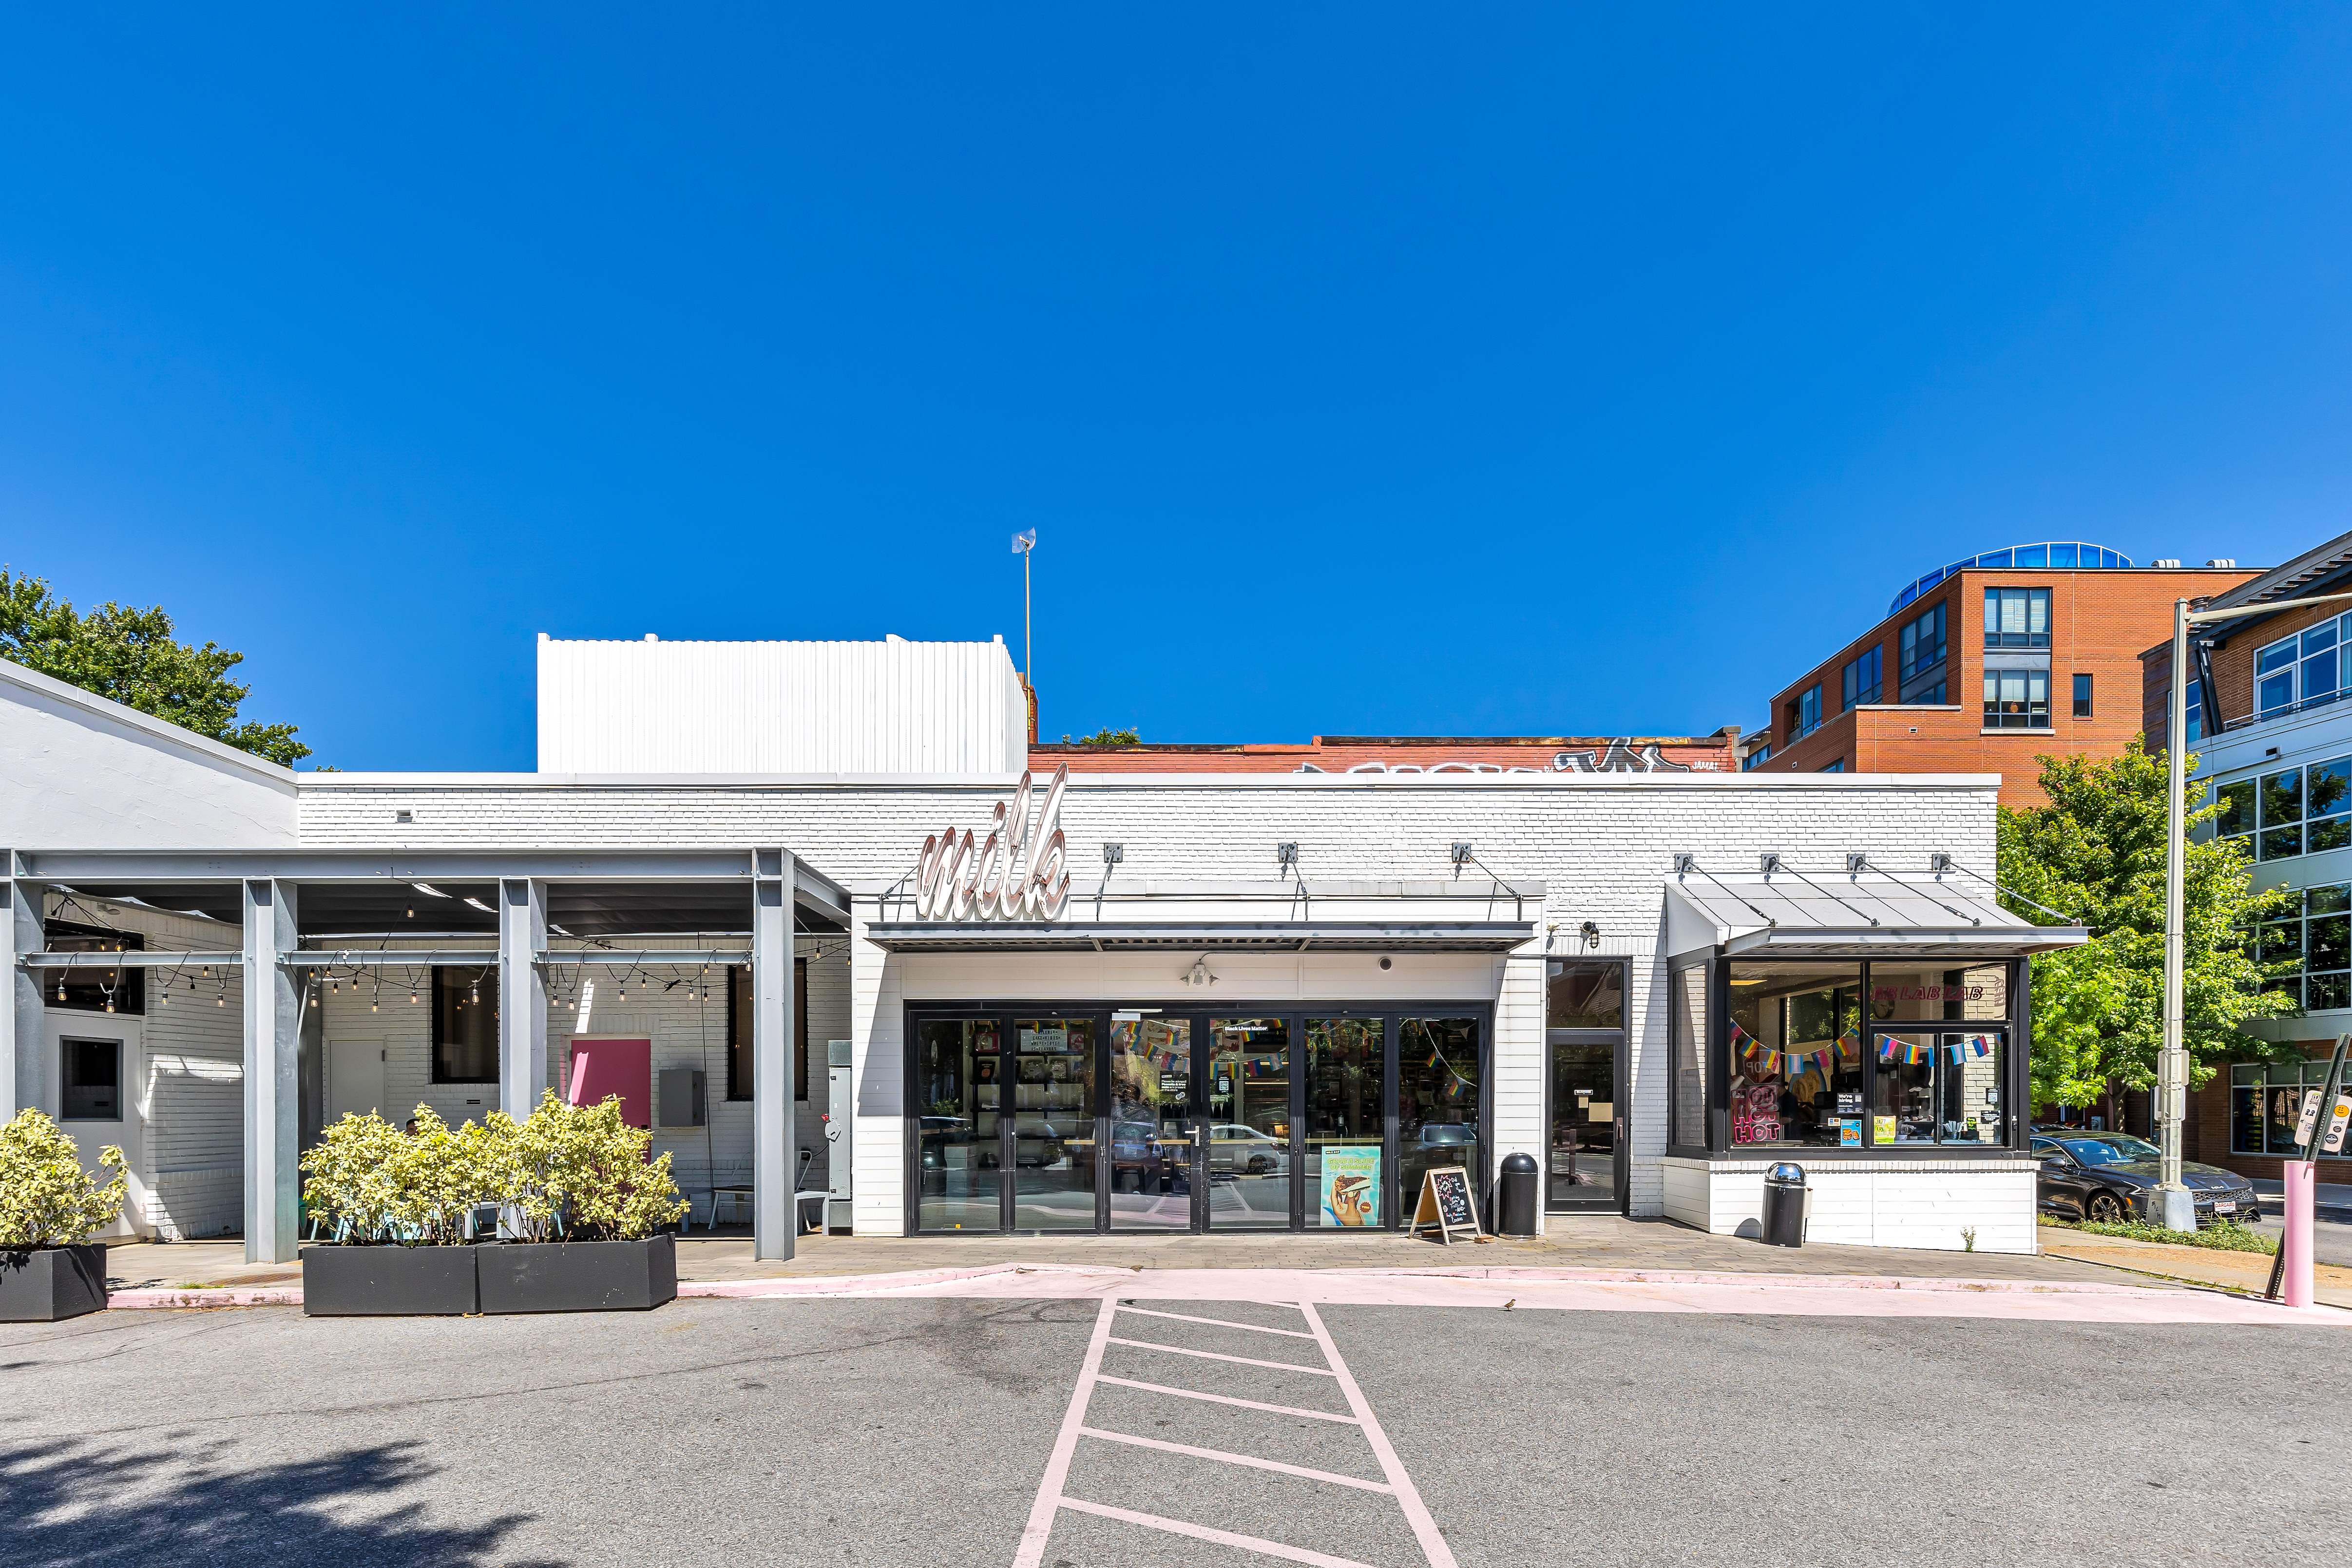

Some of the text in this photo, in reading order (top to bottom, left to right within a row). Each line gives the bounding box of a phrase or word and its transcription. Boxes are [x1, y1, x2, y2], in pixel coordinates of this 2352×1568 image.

[916, 761, 1071, 920] milk
[1900, 986, 1941, 1000] LAB
[1943, 986, 1983, 1000] LAB
[1735, 1122, 1780, 1143] HOT
